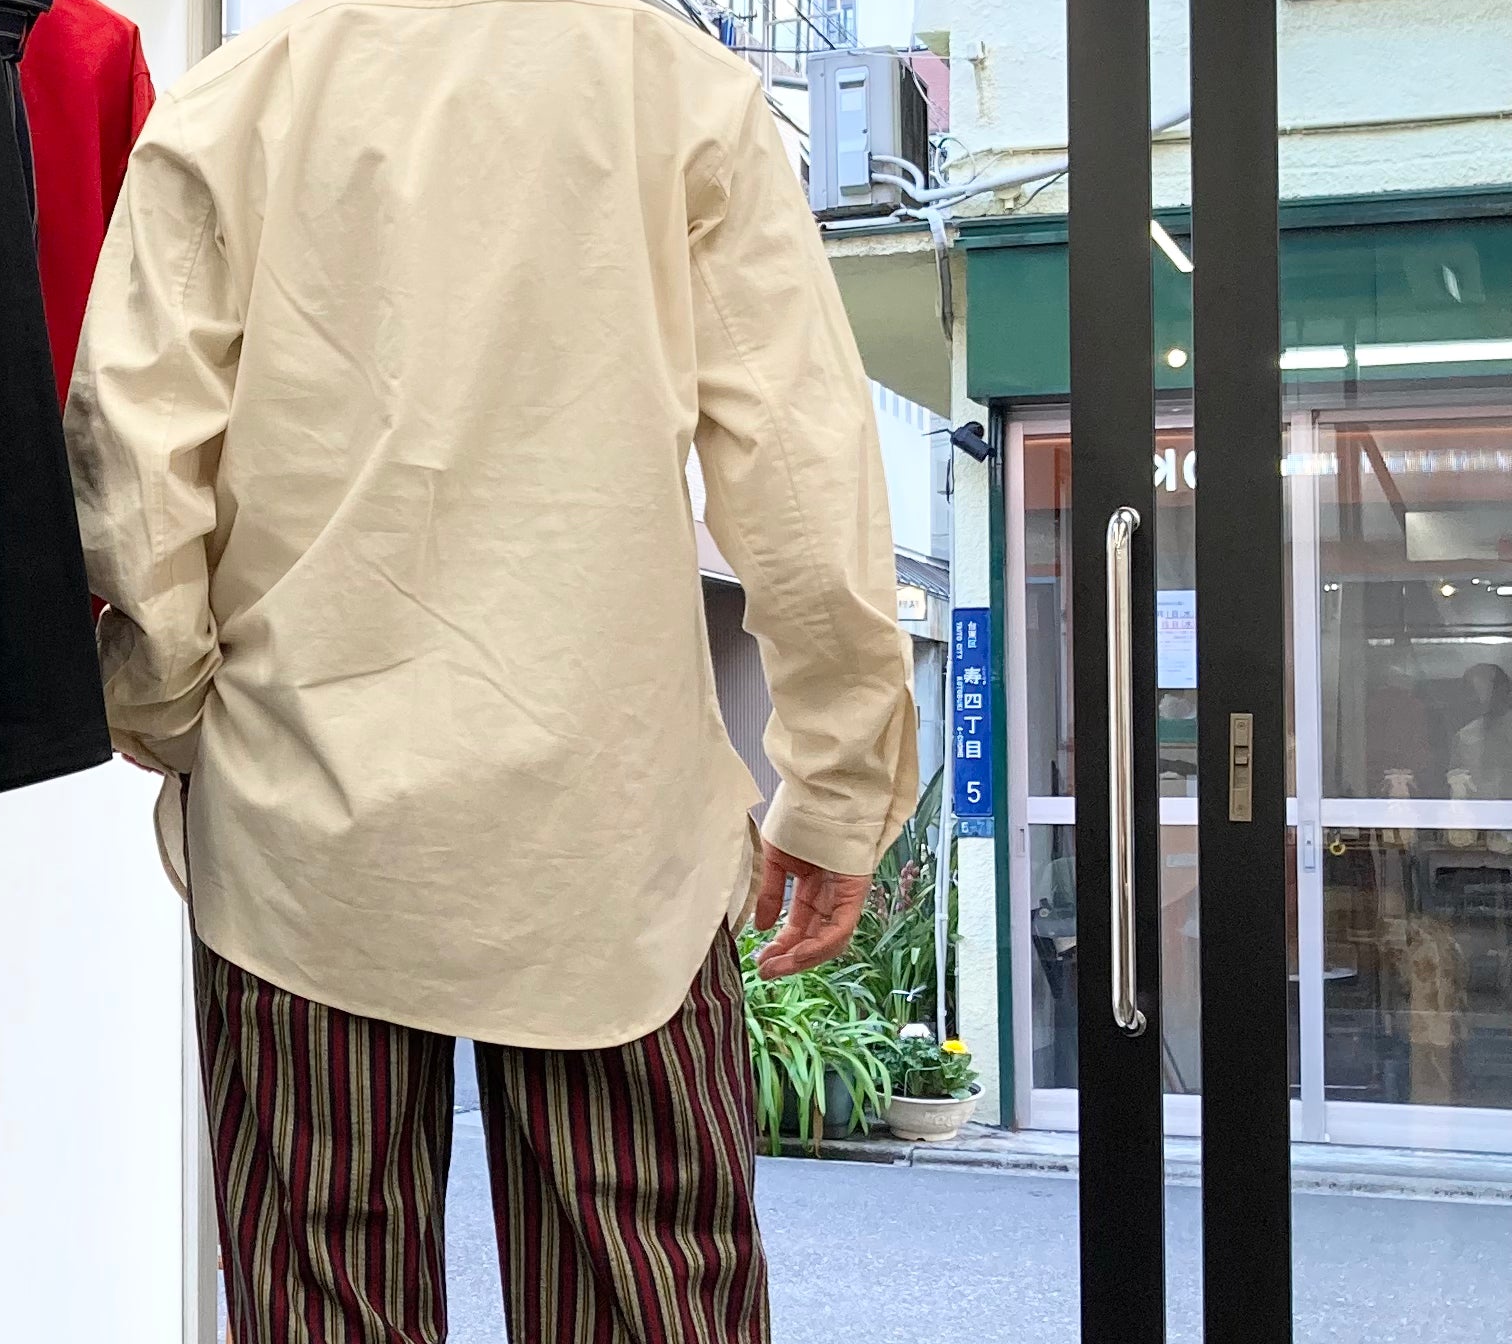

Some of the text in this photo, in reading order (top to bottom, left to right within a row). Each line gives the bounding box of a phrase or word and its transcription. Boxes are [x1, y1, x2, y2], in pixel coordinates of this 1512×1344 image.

[963, 666, 982, 759] 寿四丁目
[967, 781, 981, 804] 5
